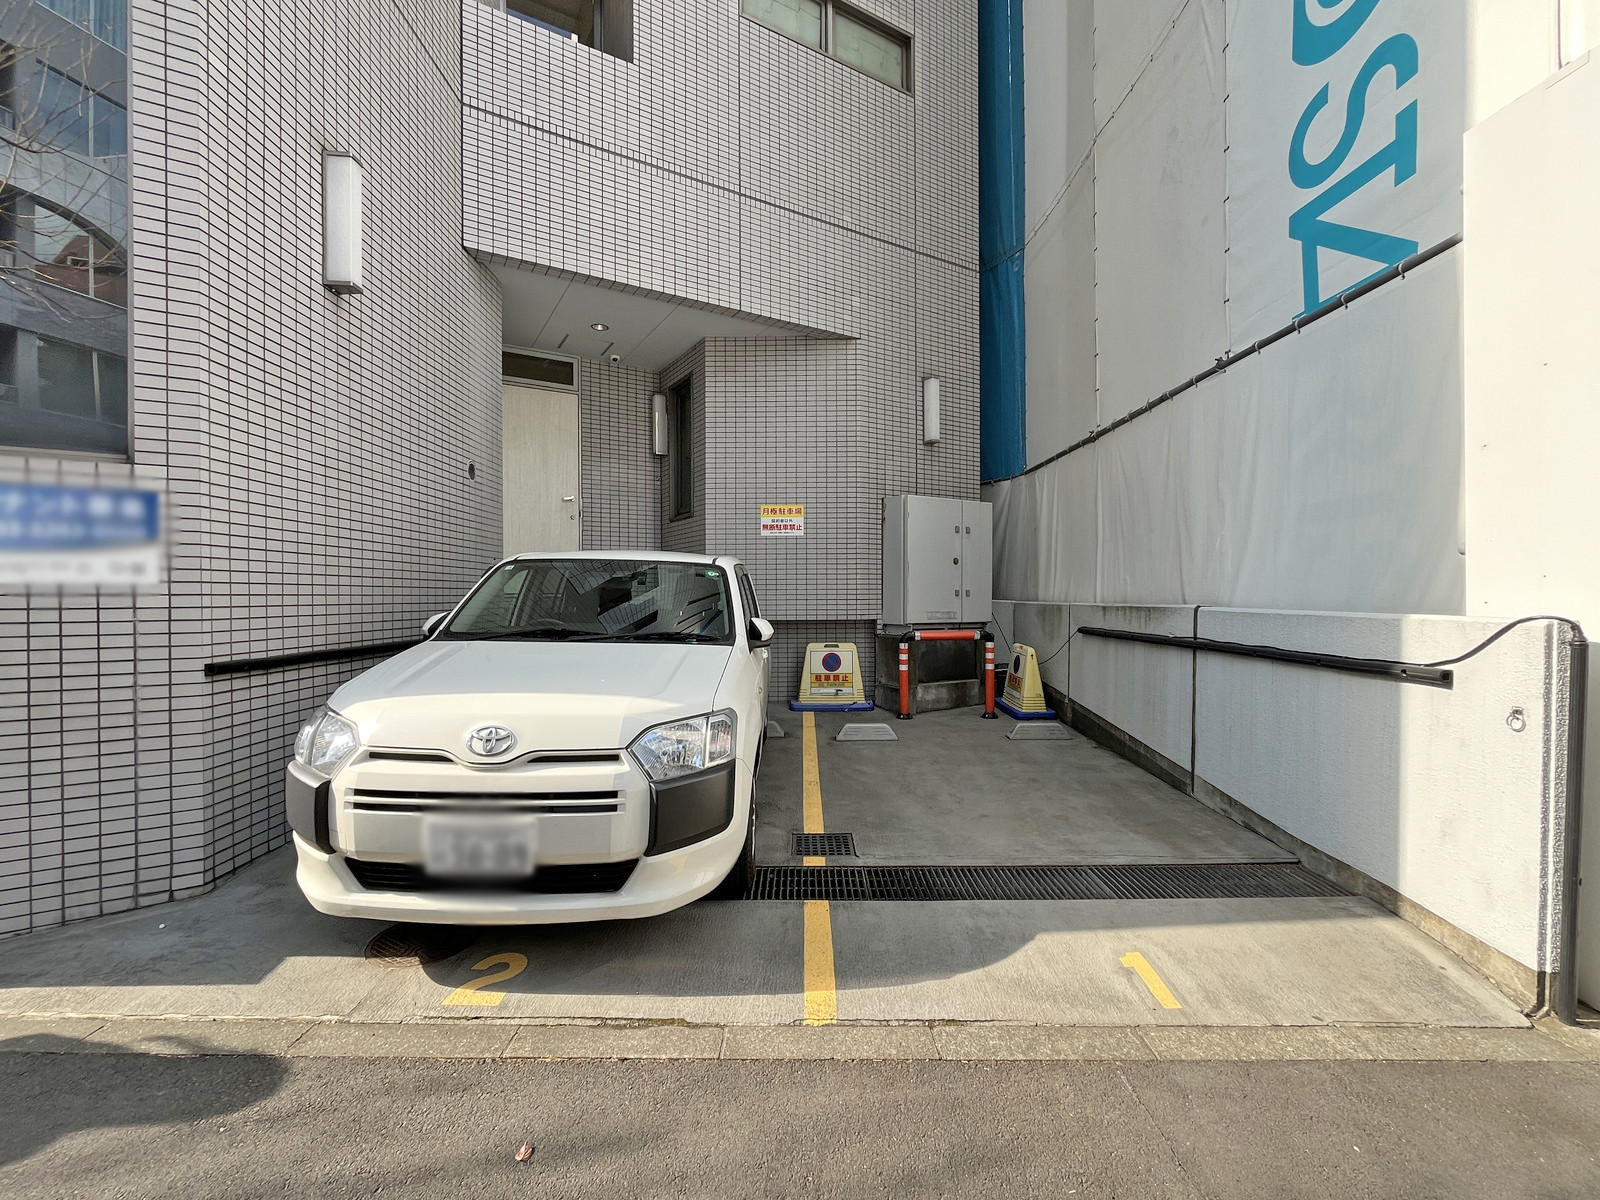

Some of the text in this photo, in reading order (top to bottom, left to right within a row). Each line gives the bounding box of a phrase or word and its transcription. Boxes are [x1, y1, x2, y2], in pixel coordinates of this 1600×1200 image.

[762, 507, 802, 515] 月極駐車場
[814, 674, 849, 682] 駐車禁止
[442, 952, 528, 1006] 2
[1119, 952, 1183, 1010] 1
